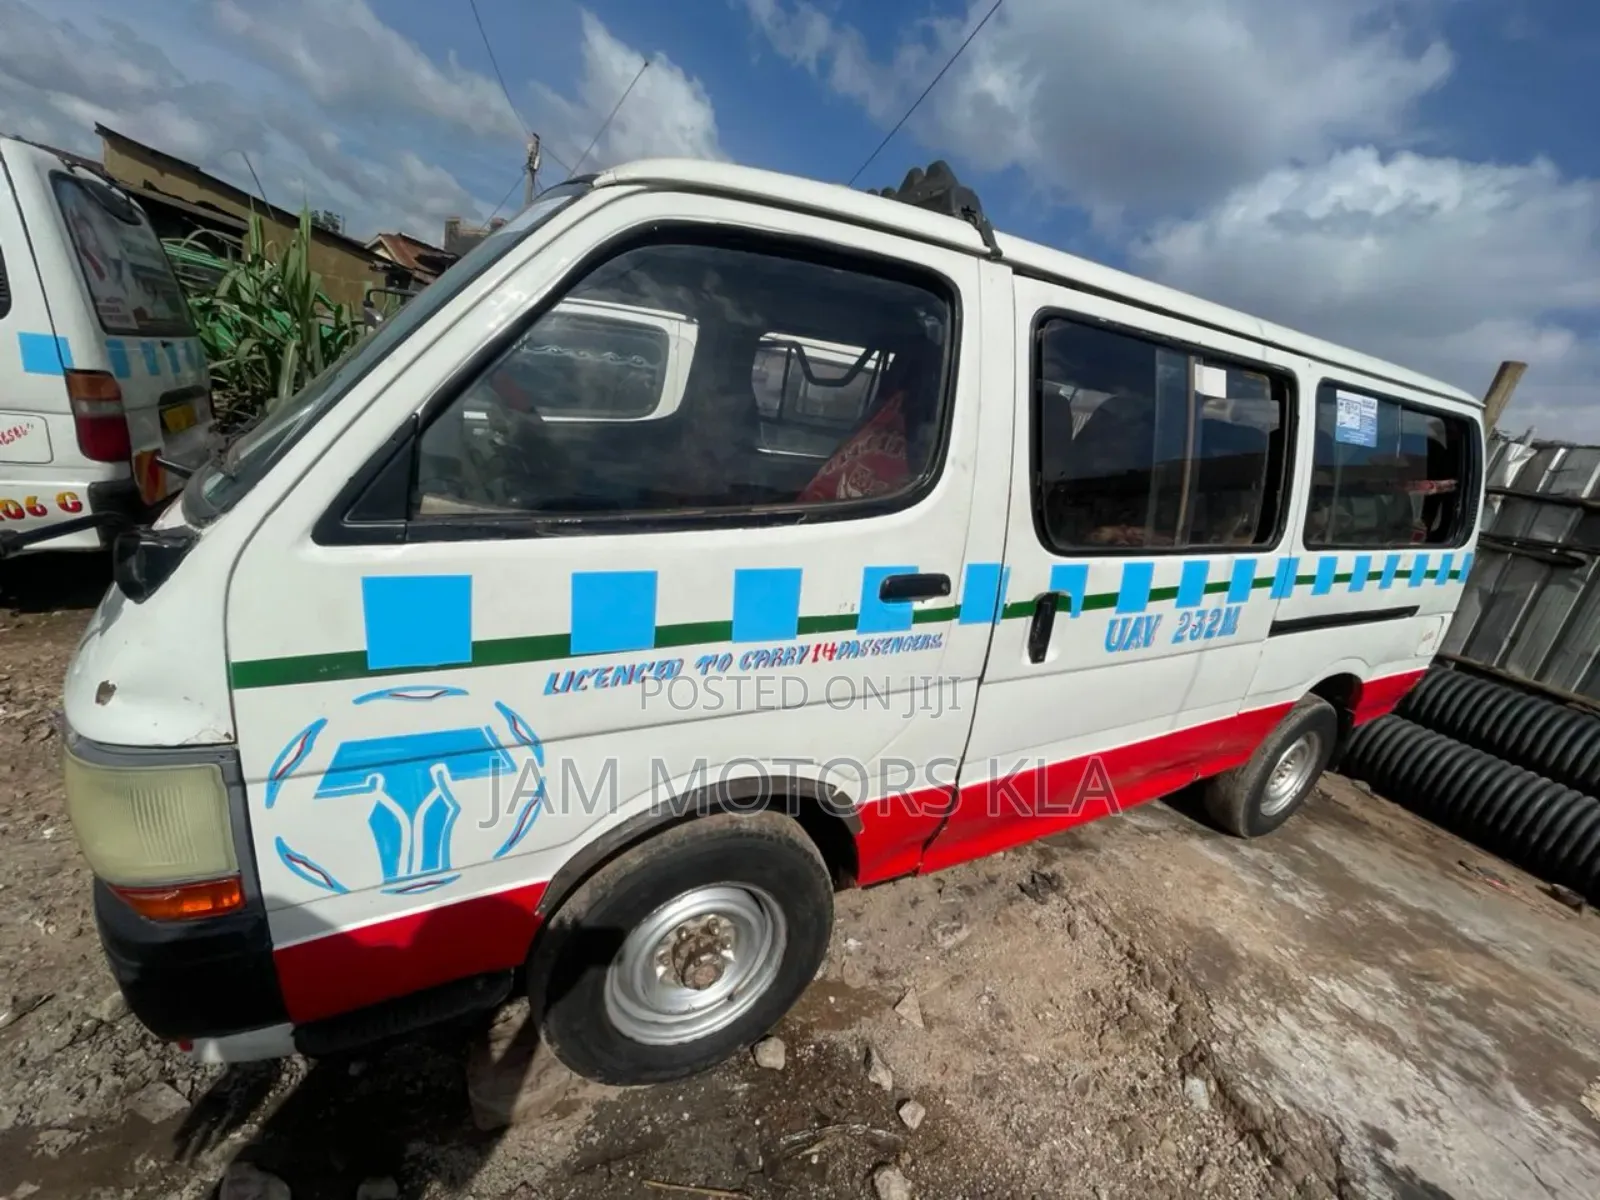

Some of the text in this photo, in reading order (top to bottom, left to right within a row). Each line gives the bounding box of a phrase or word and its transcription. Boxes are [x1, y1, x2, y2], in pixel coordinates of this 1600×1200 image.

[1104, 605, 1242, 653] UAV 232M
[543, 632, 943, 696] LICENCED TO CARRY 14 PASSENGERS
